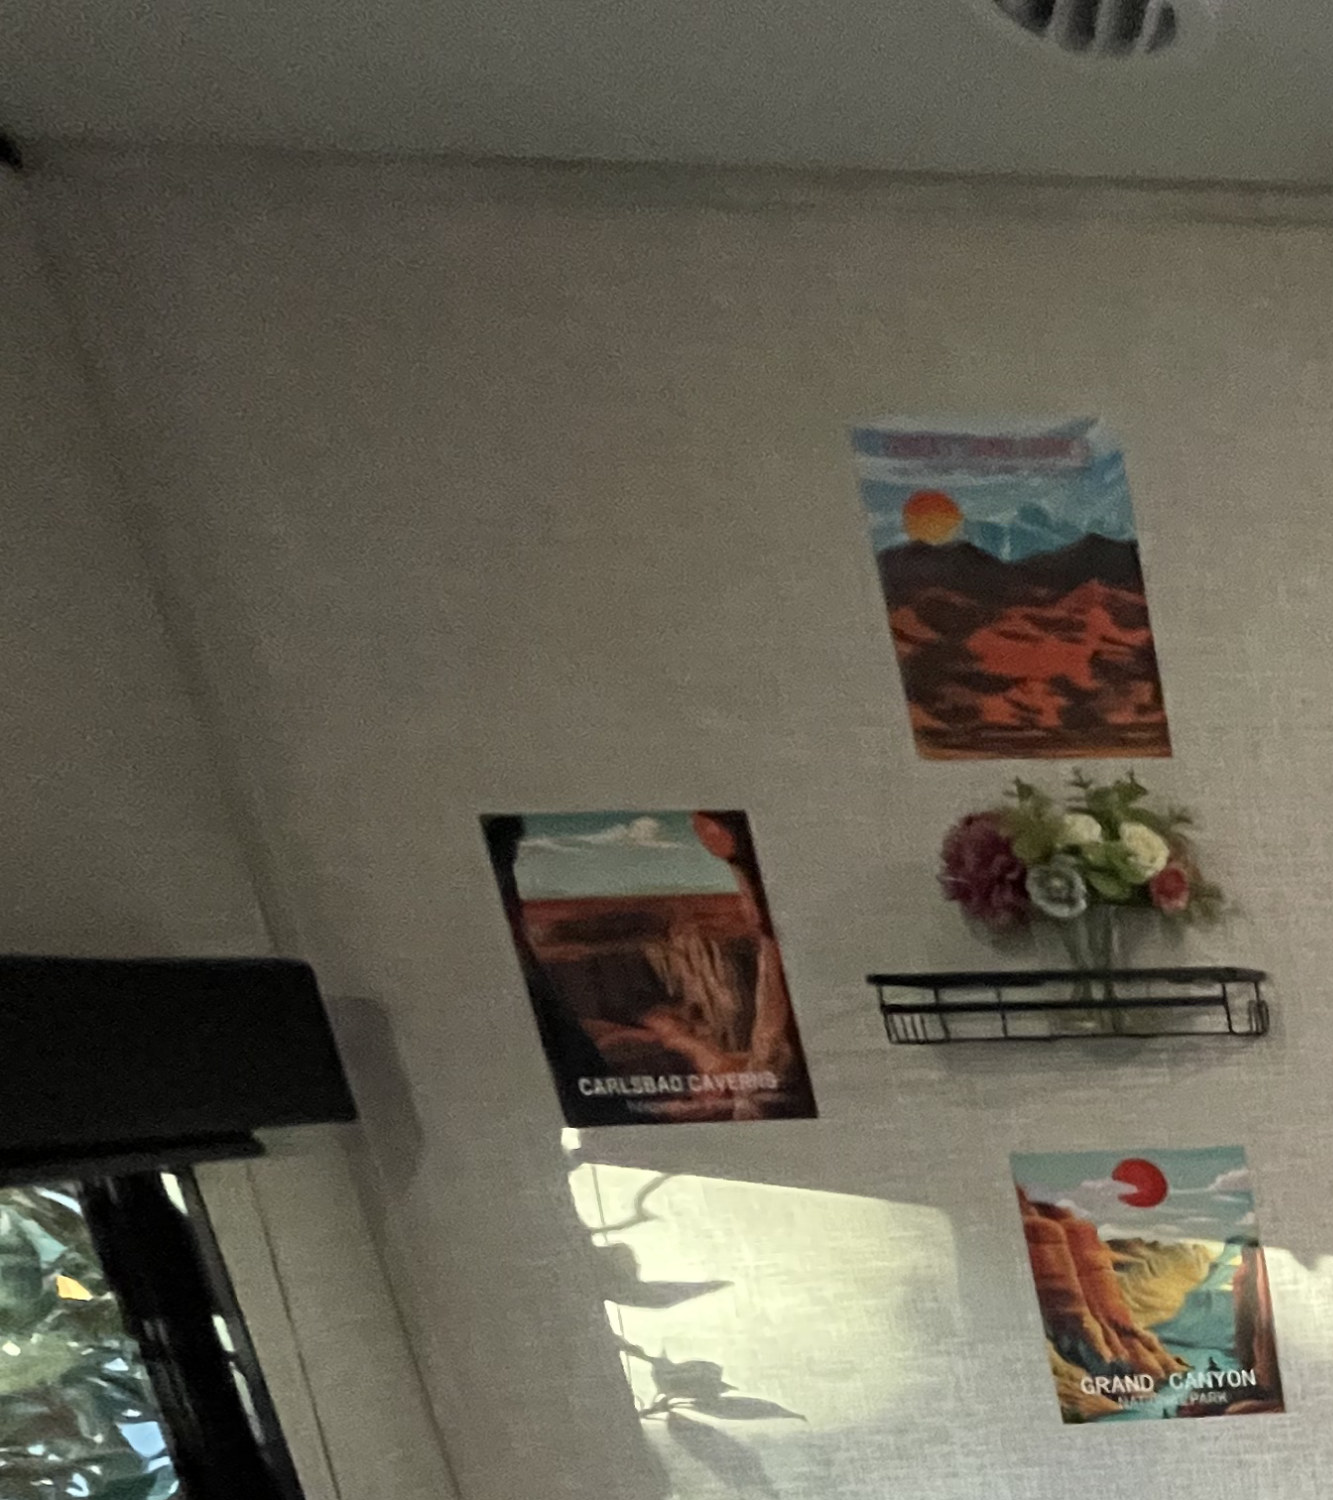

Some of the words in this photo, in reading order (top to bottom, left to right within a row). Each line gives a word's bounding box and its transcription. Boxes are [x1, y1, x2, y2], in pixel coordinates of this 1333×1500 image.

[577, 1075, 683, 1096] CARLSBAD
[688, 1071, 779, 1092] CAVERNS
[1080, 1374, 1154, 1395] GRAND
[1169, 1369, 1257, 1390] CANYON
